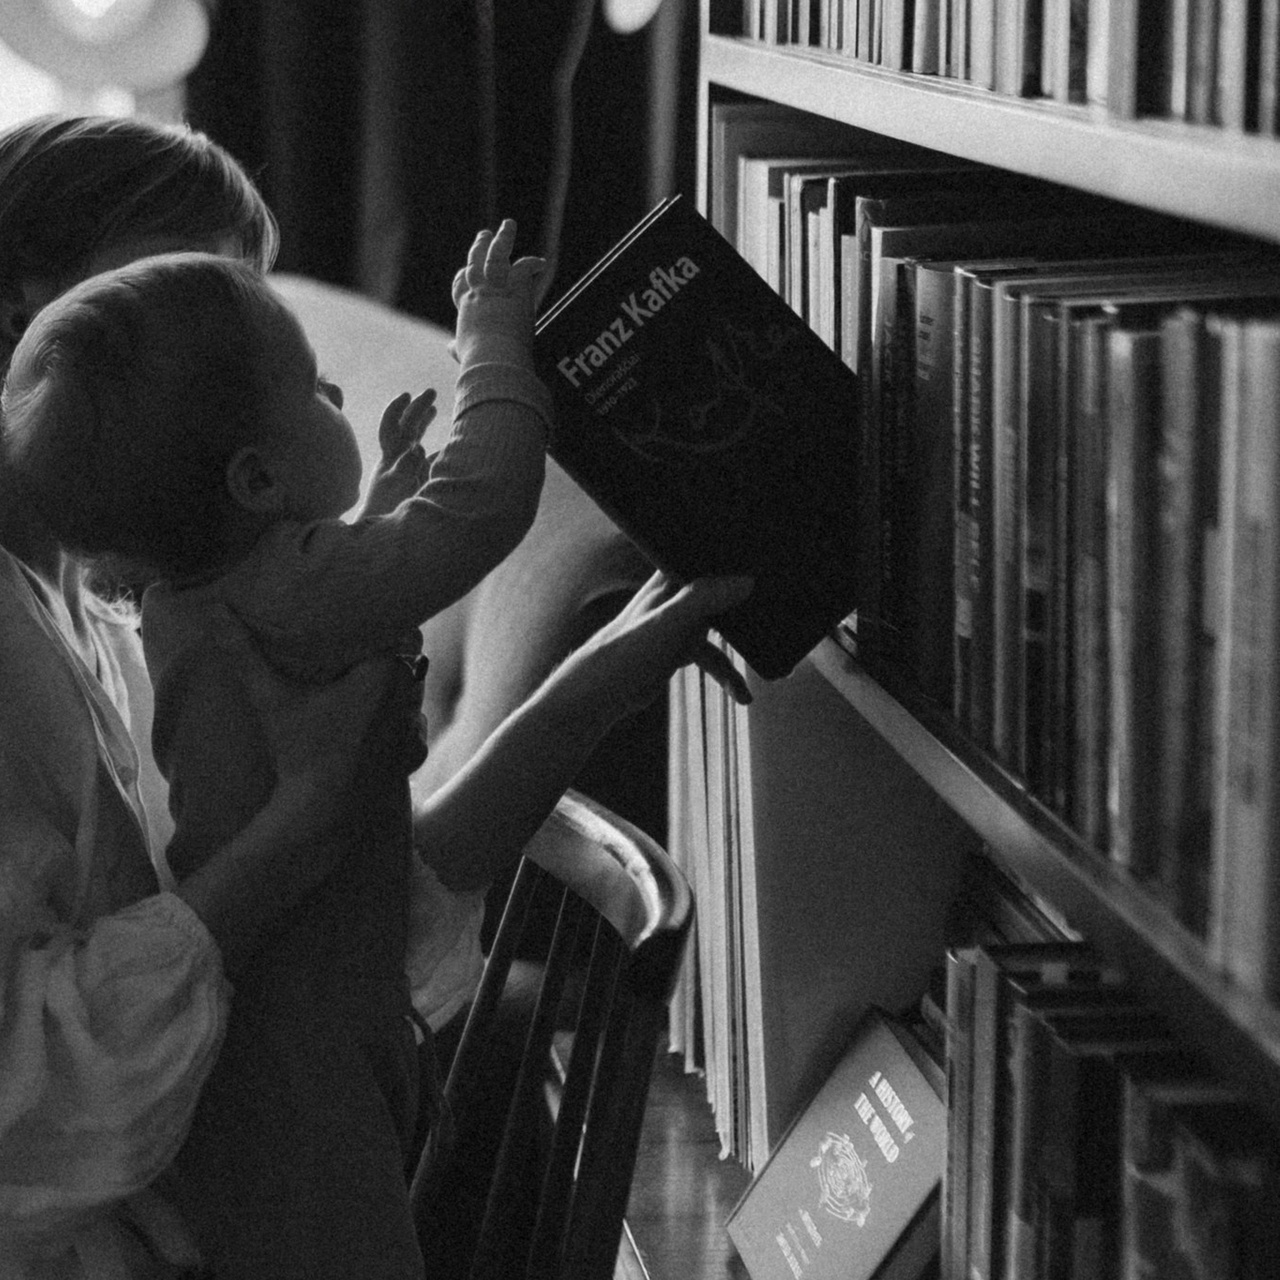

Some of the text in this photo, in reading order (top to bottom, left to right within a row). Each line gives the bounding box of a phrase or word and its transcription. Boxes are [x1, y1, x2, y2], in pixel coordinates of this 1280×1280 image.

[556, 256, 700, 388] Franz Kafka
[854, 1092, 900, 1163] THE WORLD
[868, 1071, 882, 1089] A
[875, 1078, 914, 1134] HISTORY
